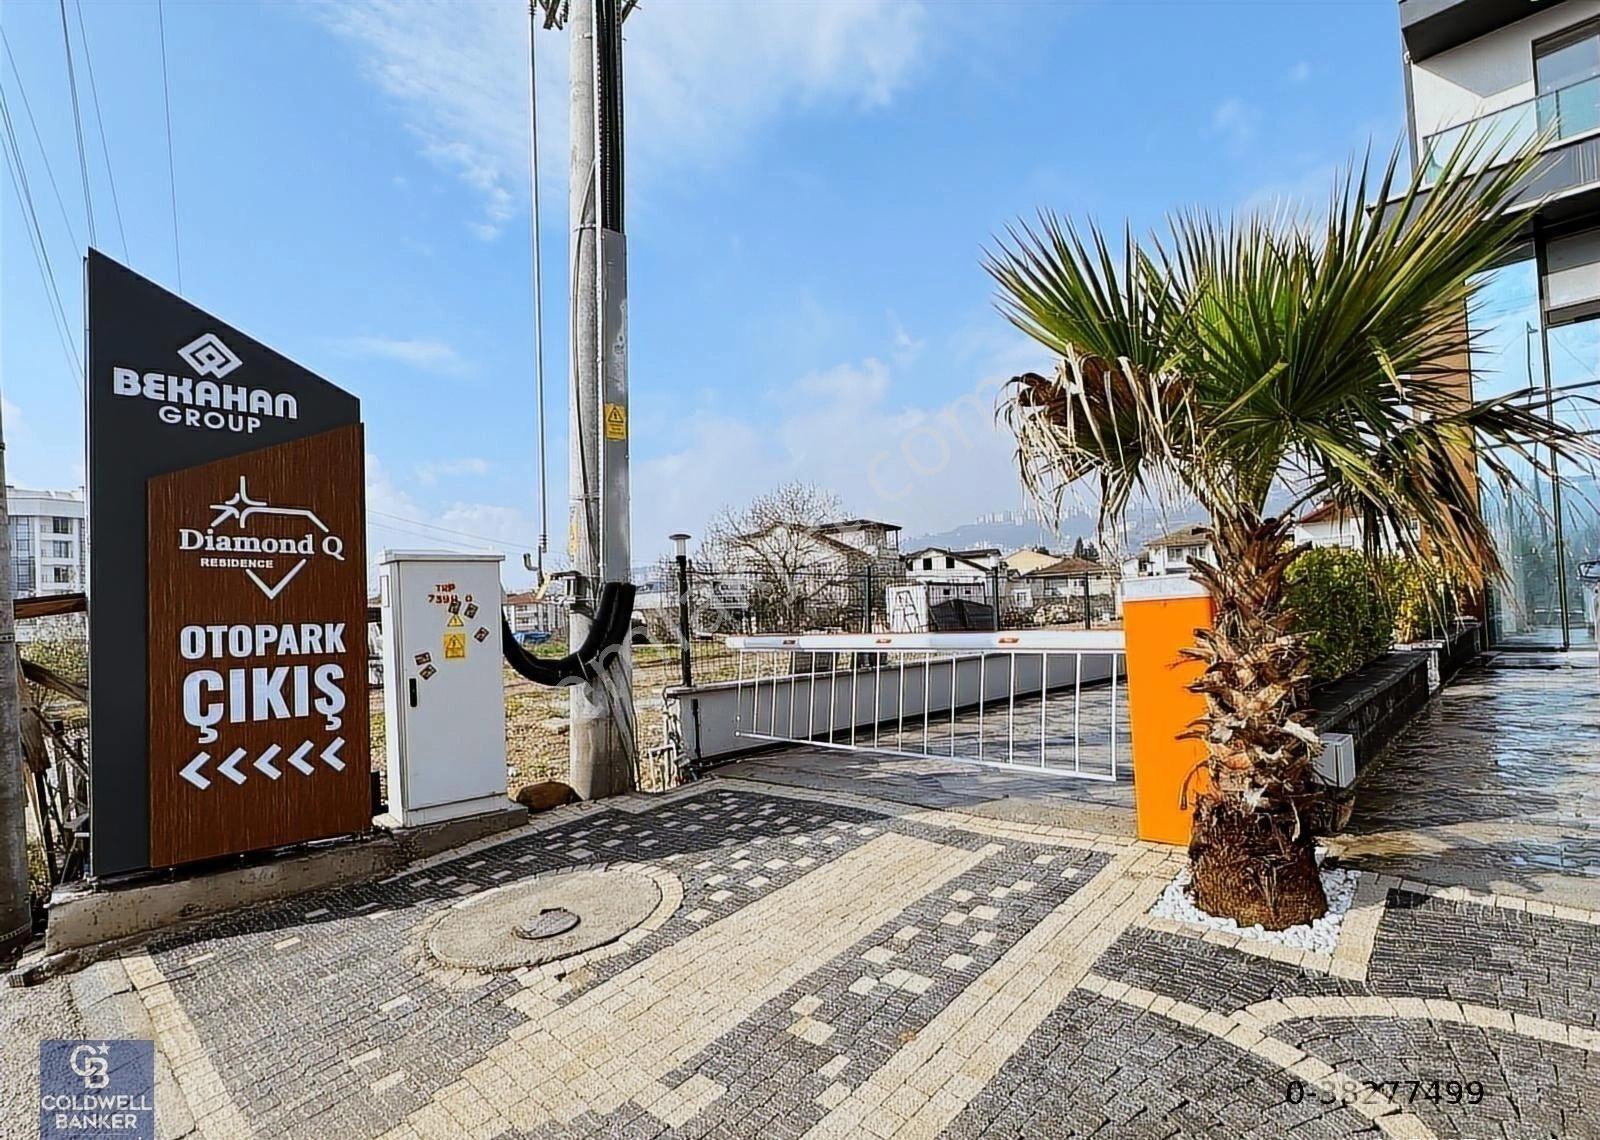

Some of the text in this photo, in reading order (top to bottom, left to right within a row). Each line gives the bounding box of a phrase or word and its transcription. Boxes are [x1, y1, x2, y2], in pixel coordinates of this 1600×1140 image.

[113, 366, 298, 419] BEKAHAN
[158, 405, 261, 433] GROUP
[179, 528, 345, 561] Diamond Q
[200, 557, 274, 569] RESIDENCE
[180, 623, 346, 660] OTOPARK
[182, 663, 346, 744] ÇIKIŞ
